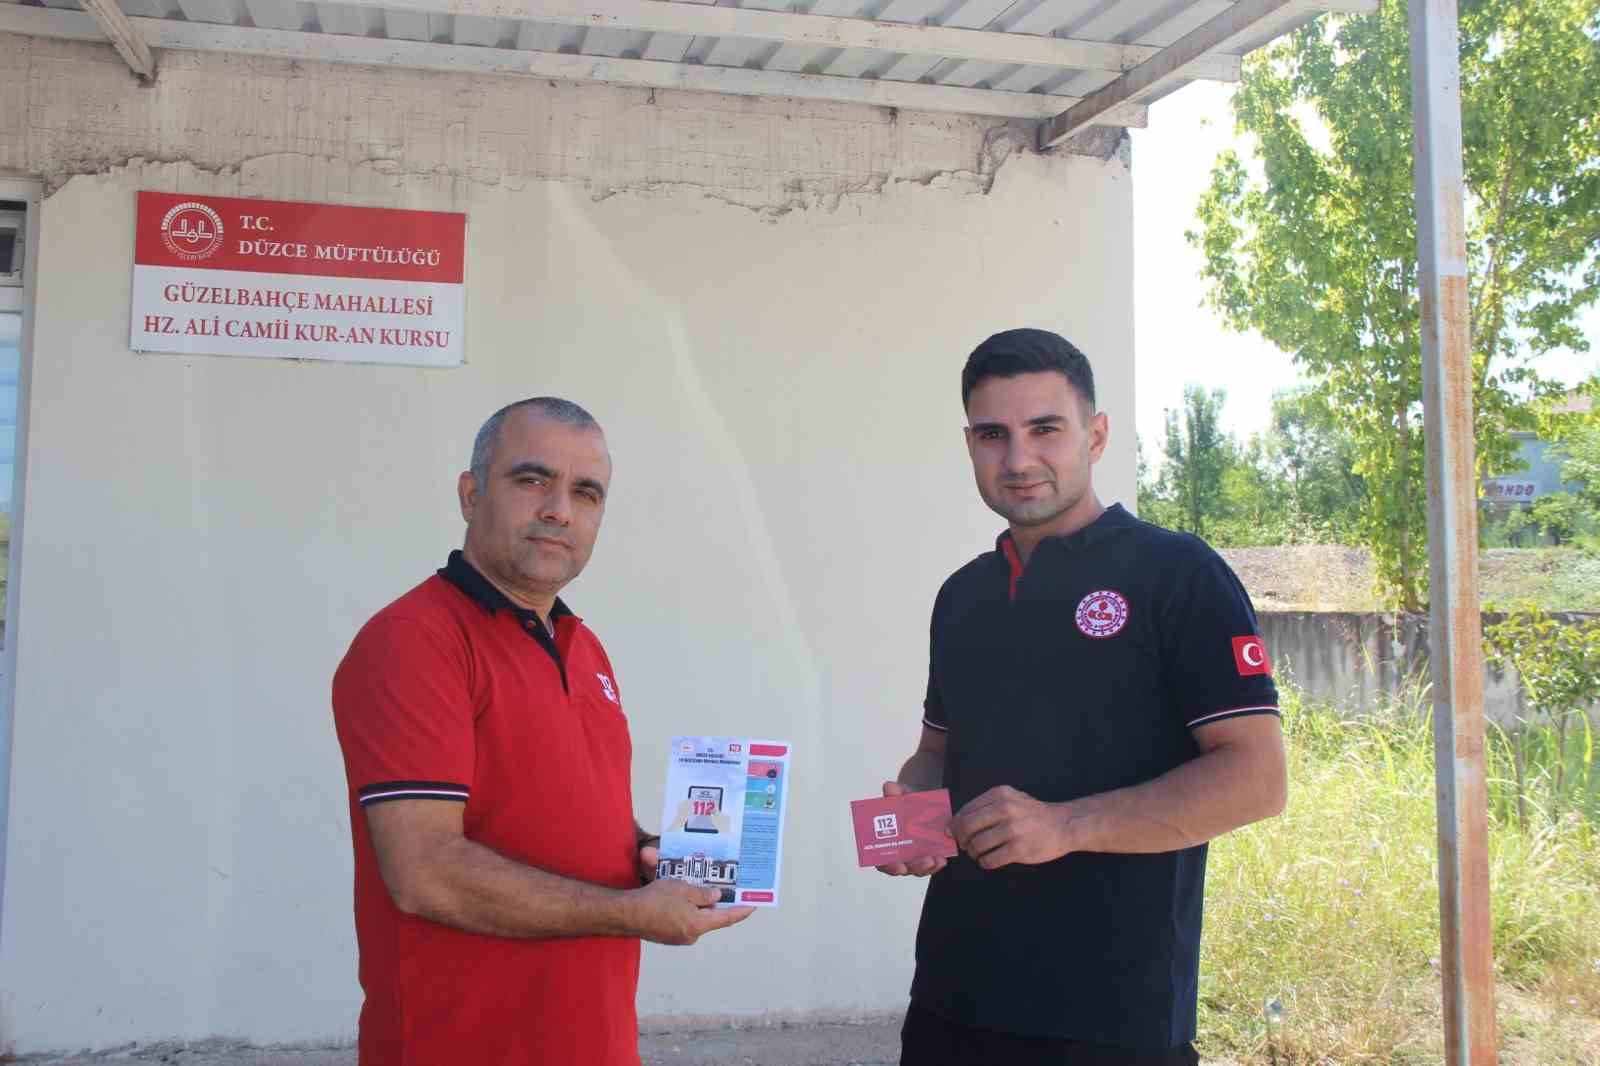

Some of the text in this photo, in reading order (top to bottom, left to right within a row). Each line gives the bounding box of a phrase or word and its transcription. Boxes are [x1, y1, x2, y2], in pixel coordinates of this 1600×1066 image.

[239, 215, 275, 232] T.C.
[238, 240, 308, 259] DÜZCE
[315, 244, 441, 267] MÜFTÜLÜĞÜ
[164, 282, 434, 317] GÜZELBAHÇE MAHALLESİ
[143, 315, 450, 349] HZ. ALİ CAMİİ KUR-AN KURSU
[693, 800, 716, 816] 112
[877, 817, 894, 829] 112
